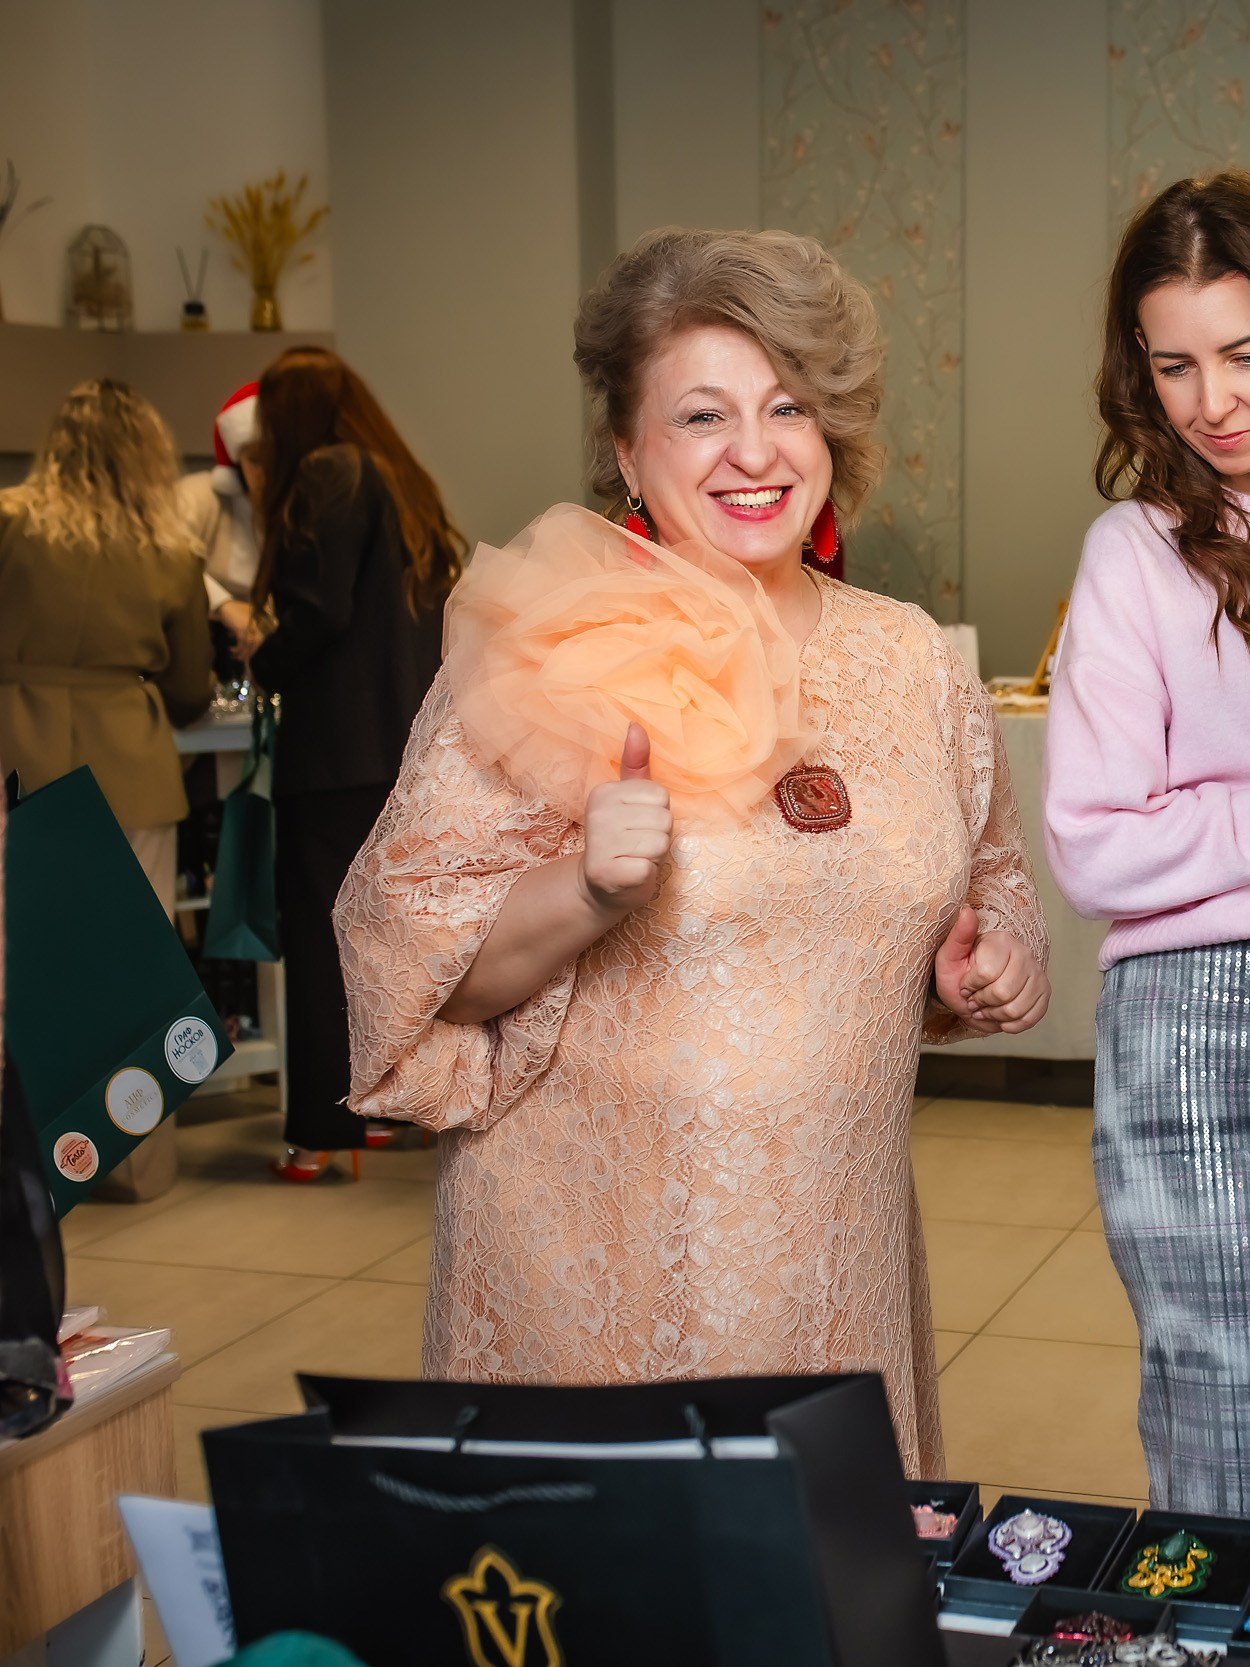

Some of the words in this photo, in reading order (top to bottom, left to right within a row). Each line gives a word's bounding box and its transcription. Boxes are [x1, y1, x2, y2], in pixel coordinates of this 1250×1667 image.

[171, 1029, 204, 1060] НОСКОВ
[174, 1027, 192, 1046] ГРАФ
[472, 1601, 532, 1667] V
